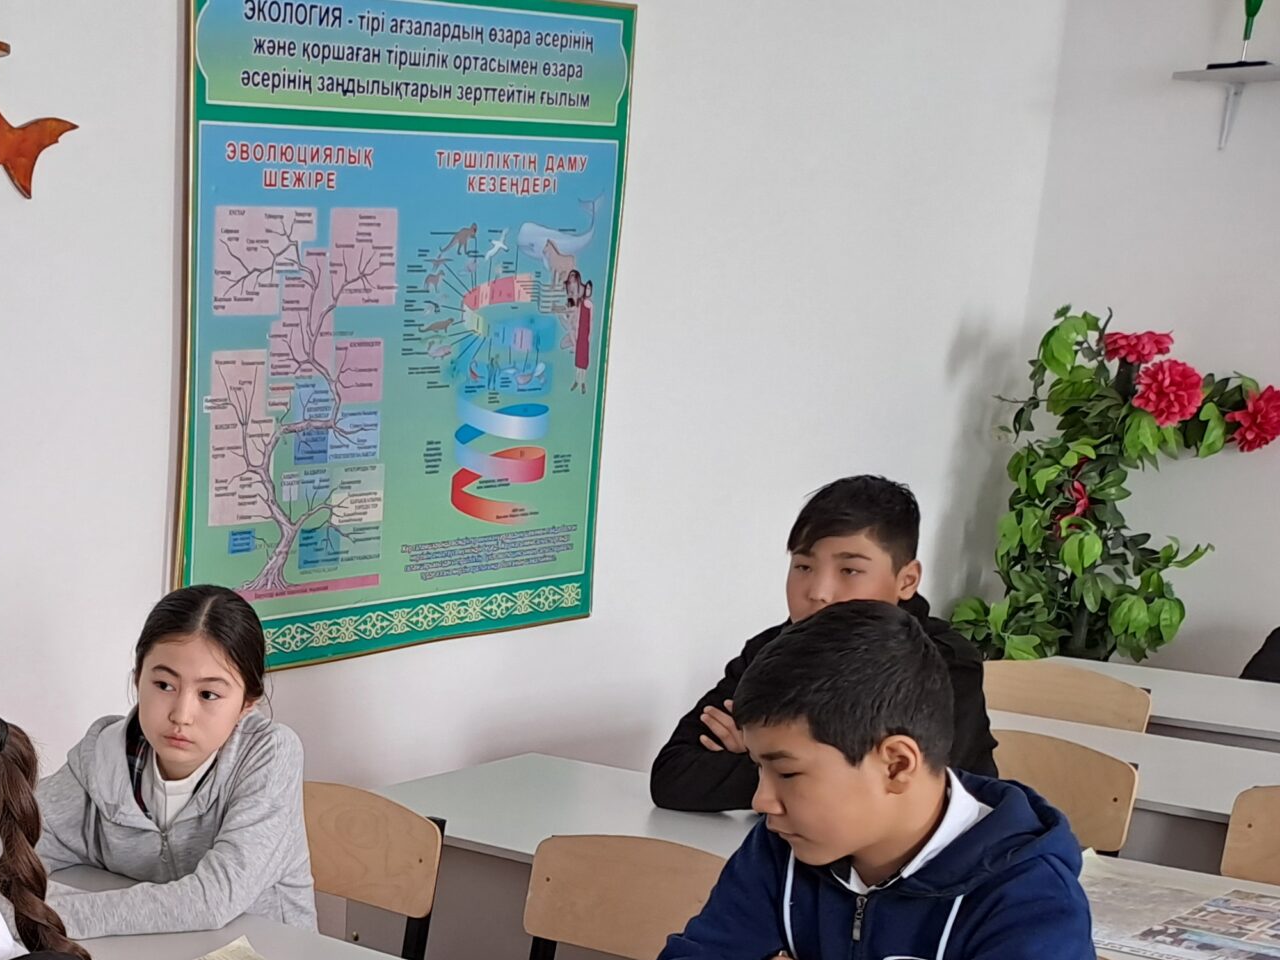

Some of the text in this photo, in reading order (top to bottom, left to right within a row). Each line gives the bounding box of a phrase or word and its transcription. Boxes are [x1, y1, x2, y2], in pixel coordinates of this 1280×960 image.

[244, 0, 342, 28] ЭКОЛОГИЯ
[358, 11, 385, 36] тірі
[390, 17, 484, 44] ағзалардың
[489, 28, 531, 48] өзара
[536, 30, 593, 53] әсерінің
[253, 38, 583, 82] және қоршаған тіршілік ортасымен өзара
[241, 68, 590, 108] әсерінің заңдылықтарын зерттейтін ғылым
[225, 142, 374, 169] ЭВОЛЮЦИЯЛЫҚ
[436, 150, 588, 174] ТІРШІЛІКТІҢ ДАМУ
[263, 170, 336, 190] ШЕЖІРЕ
[467, 176, 558, 196] КЕЗЕҢДЕРІ
